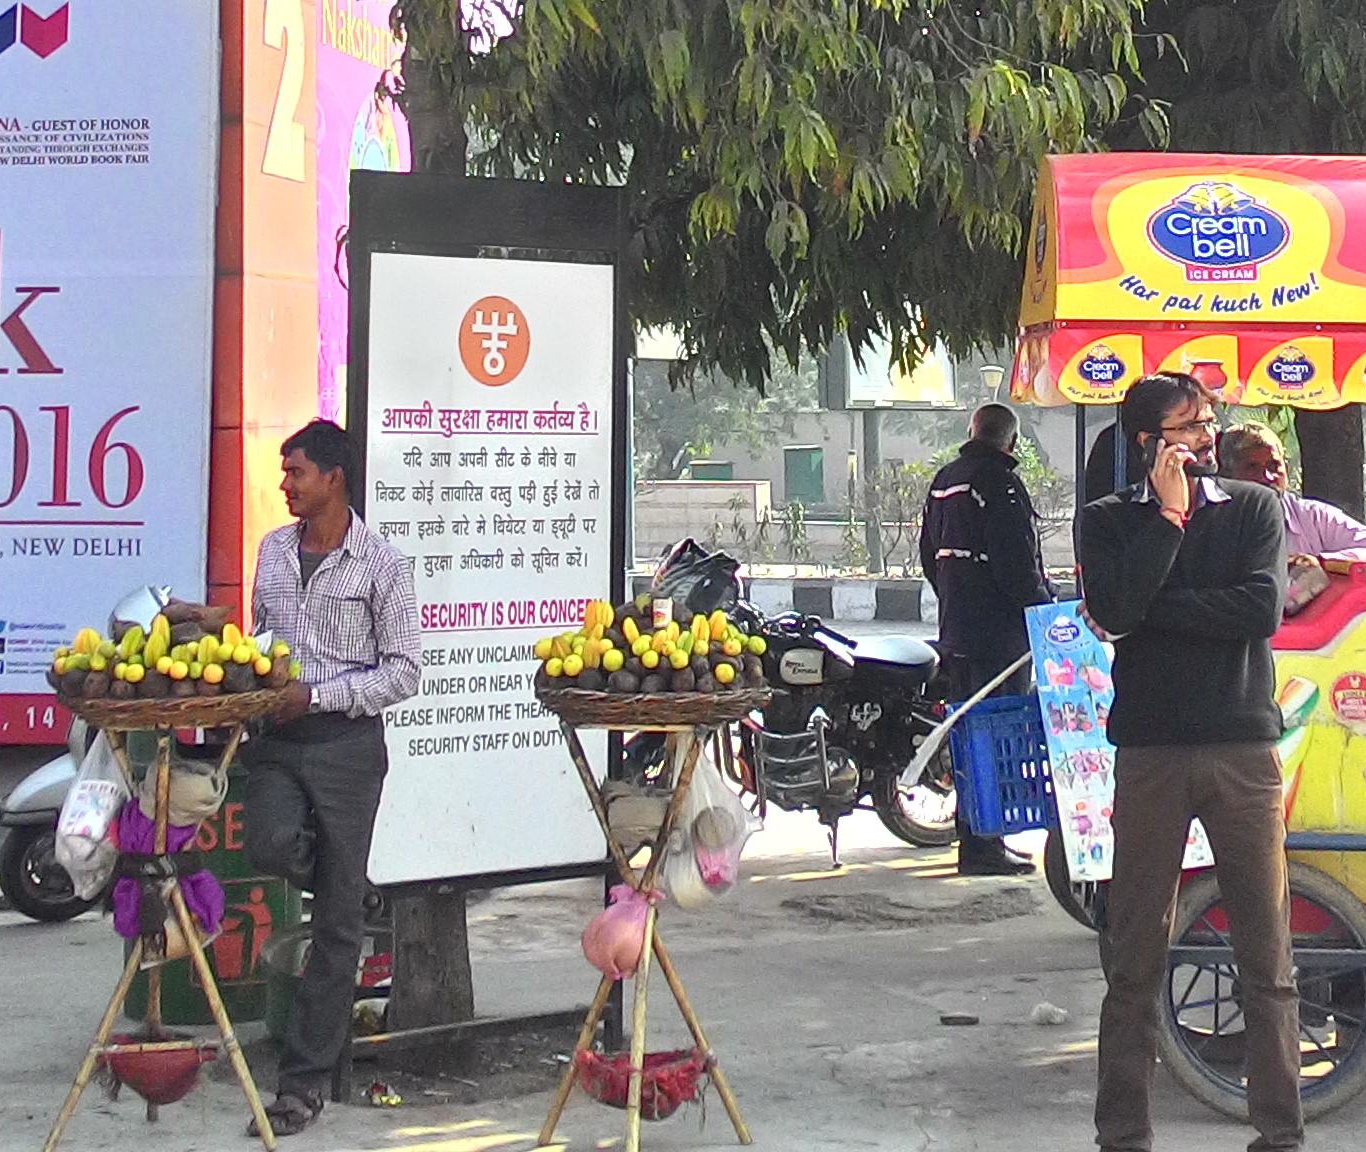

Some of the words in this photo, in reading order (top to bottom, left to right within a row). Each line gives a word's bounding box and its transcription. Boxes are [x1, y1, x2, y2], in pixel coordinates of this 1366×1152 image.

[31, 119, 75, 132] GUEST
[79, 119, 97, 131] OF
[100, 118, 151, 131] HONOR
[45, 134, 59, 143] OF
[63, 132, 150, 143] CIVILIZATIONS
[12, 156, 46, 166] DELHI
[48, 156, 88, 165] WORLD
[91, 155, 123, 165] BOOK
[126, 154, 150, 164] FAIR
[1166, 213, 1267, 236] Cream
[1192, 234, 1251, 258] bell
[1189, 268, 1210, 280] ICE
[1212, 267, 1254, 280] CREAM
[1119, 274, 1160, 302] Har
[1161, 293, 1203, 313] pal
[1210, 292, 1263, 313] kuch
[1271, 271, 1321, 308] New!
[1082, 360, 1119, 372] Cream
[1091, 370, 1113, 380] bell
[1272, 362, 1309, 374] Cream
[1280, 371, 1302, 382] bell
[382, 401, 433, 429] आपकी
[438, 409, 481, 438] सुरक्षा
[486, 410, 528, 431] हमारा
[533, 401, 575, 430] कर्तव्य
[403, 445, 423, 468] यदि
[430, 452, 451, 468] आप
[458, 446, 487, 467] अपनी
[495, 446, 515, 467] सीट
[521, 445, 532, 467] के
[538, 446, 558, 467] नीचे
[564, 453, 576, 467] या
[375, 480, 406, 503] निकट
[412, 479, 434, 505] कोई
[441, 479, 484, 502] लावारिस
[490, 485, 512, 507] वस्तु
[519, 479, 537, 504] पड़ी
[543, 479, 558, 508] हुई
[564, 478, 583, 501] देखें
[588, 478, 600, 500] तो
[379, 520, 411, 542] कृपया
[417, 514, 446, 539] इसके
[452, 513, 470, 536] बारे
[532, 519, 545, 535] या
[583, 518, 597, 534] पर
[13, 537, 65, 556] NEW
[73, 537, 142, 557] DELHI
[424, 554, 452, 577] सुरक्षा
[460, 548, 504, 571] अधिकारी
[511, 546, 524, 568] को
[531, 546, 559, 574] सूचित
[421, 602, 488, 629] SECURITY
[492, 600, 504, 626] IS
[508, 600, 536, 625] OUR
[540, 598, 603, 624] CONCE
[422, 649, 446, 667] SEE
[449, 647, 474, 666] ANY
[477, 644, 538, 665] UNCLAIM
[423, 677, 466, 696] UNDER
[469, 676, 486, 694] OR
[490, 674, 522, 693] NEAR
[26, 706, 55, 729] 14
[386, 708, 433, 728] PLEASE
[437, 705, 484, 726] INFORM
[489, 703, 512, 722] THE
[515, 701, 557, 720] THEA
[409, 737, 469, 757] SECURITY
[473, 733, 509, 752] STAFF
[513, 731, 531, 749] ON
[535, 729, 565, 748] DUTY
[196, 802, 244, 851] SE
